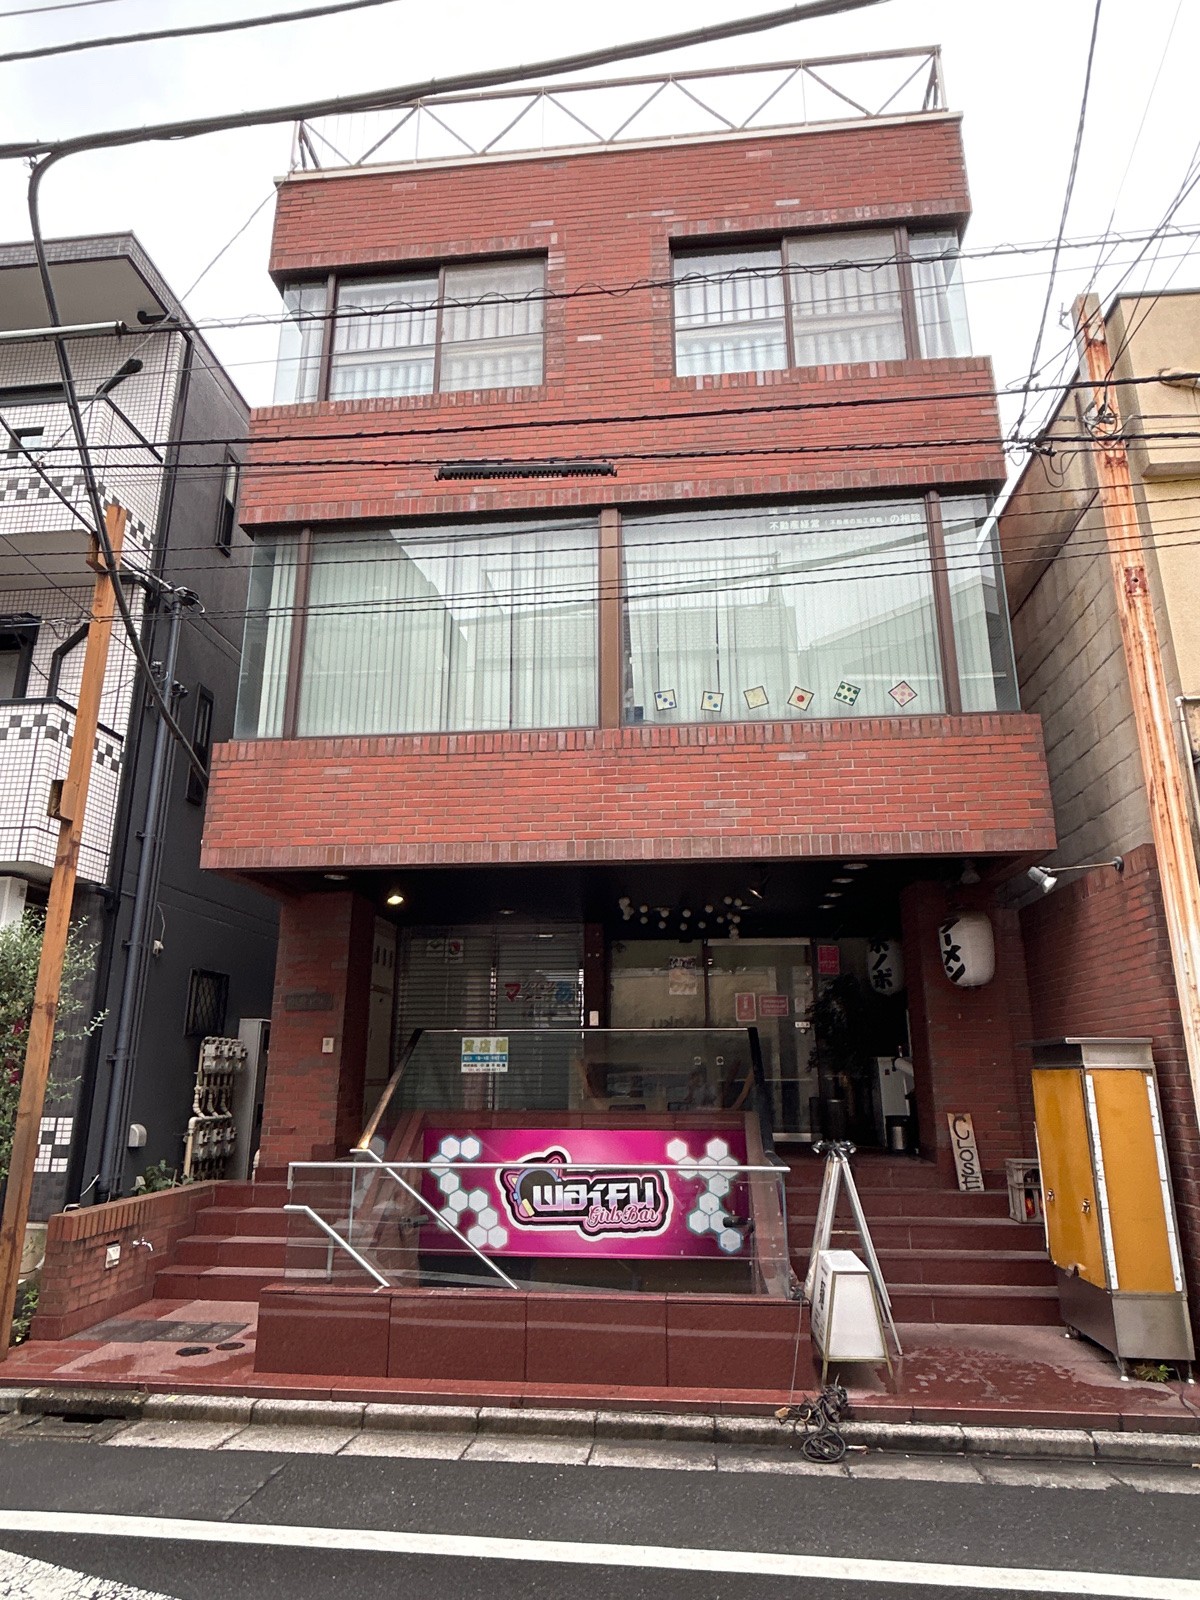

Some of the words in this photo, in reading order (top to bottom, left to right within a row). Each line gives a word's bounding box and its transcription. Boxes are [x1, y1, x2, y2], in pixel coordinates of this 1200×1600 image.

[952, 1115, 981, 1190] CLOSE
[587, 1205, 622, 1225] Girls
[623, 1204, 658, 1222] Bar
